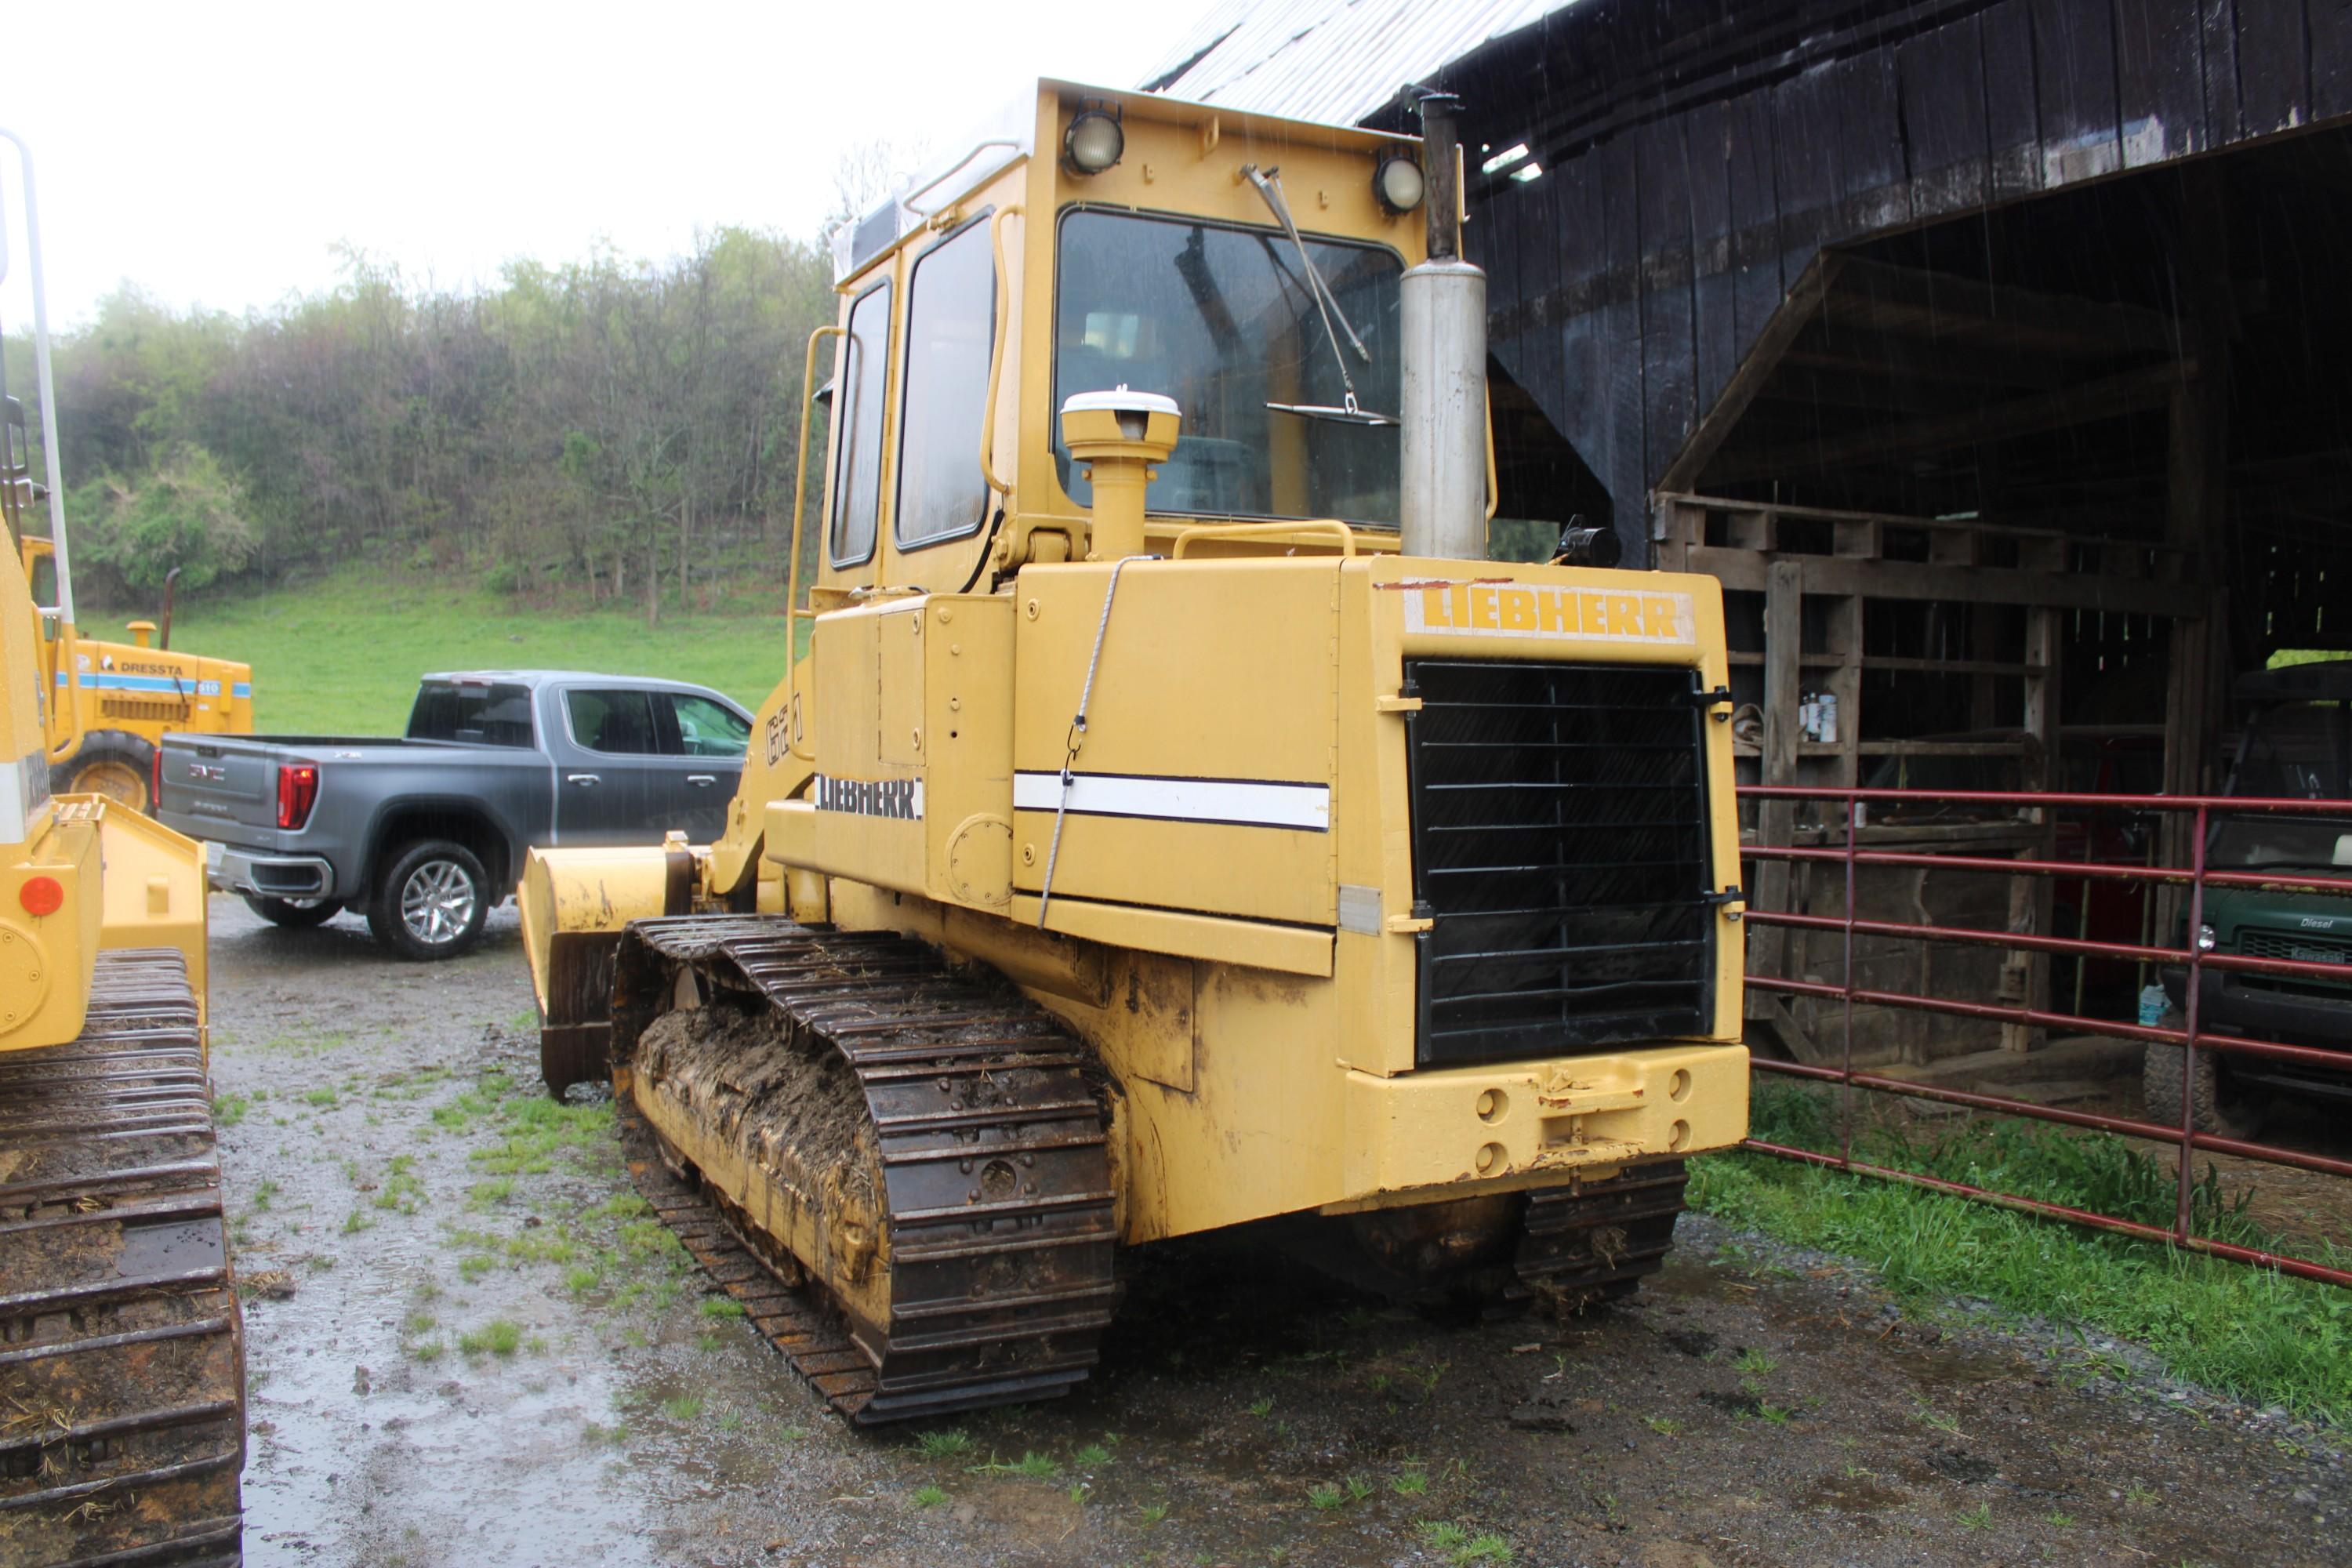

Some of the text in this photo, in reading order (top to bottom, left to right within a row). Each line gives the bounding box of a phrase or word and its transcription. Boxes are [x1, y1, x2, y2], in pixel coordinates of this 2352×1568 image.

[1422, 586, 1679, 638] LIEBHERR
[122, 662, 183, 676] DRESSTA
[820, 773, 915, 820] LIEBHERR
[2299, 917, 2334, 929] Diesel
[2291, 946, 2346, 964] Kawasaki
